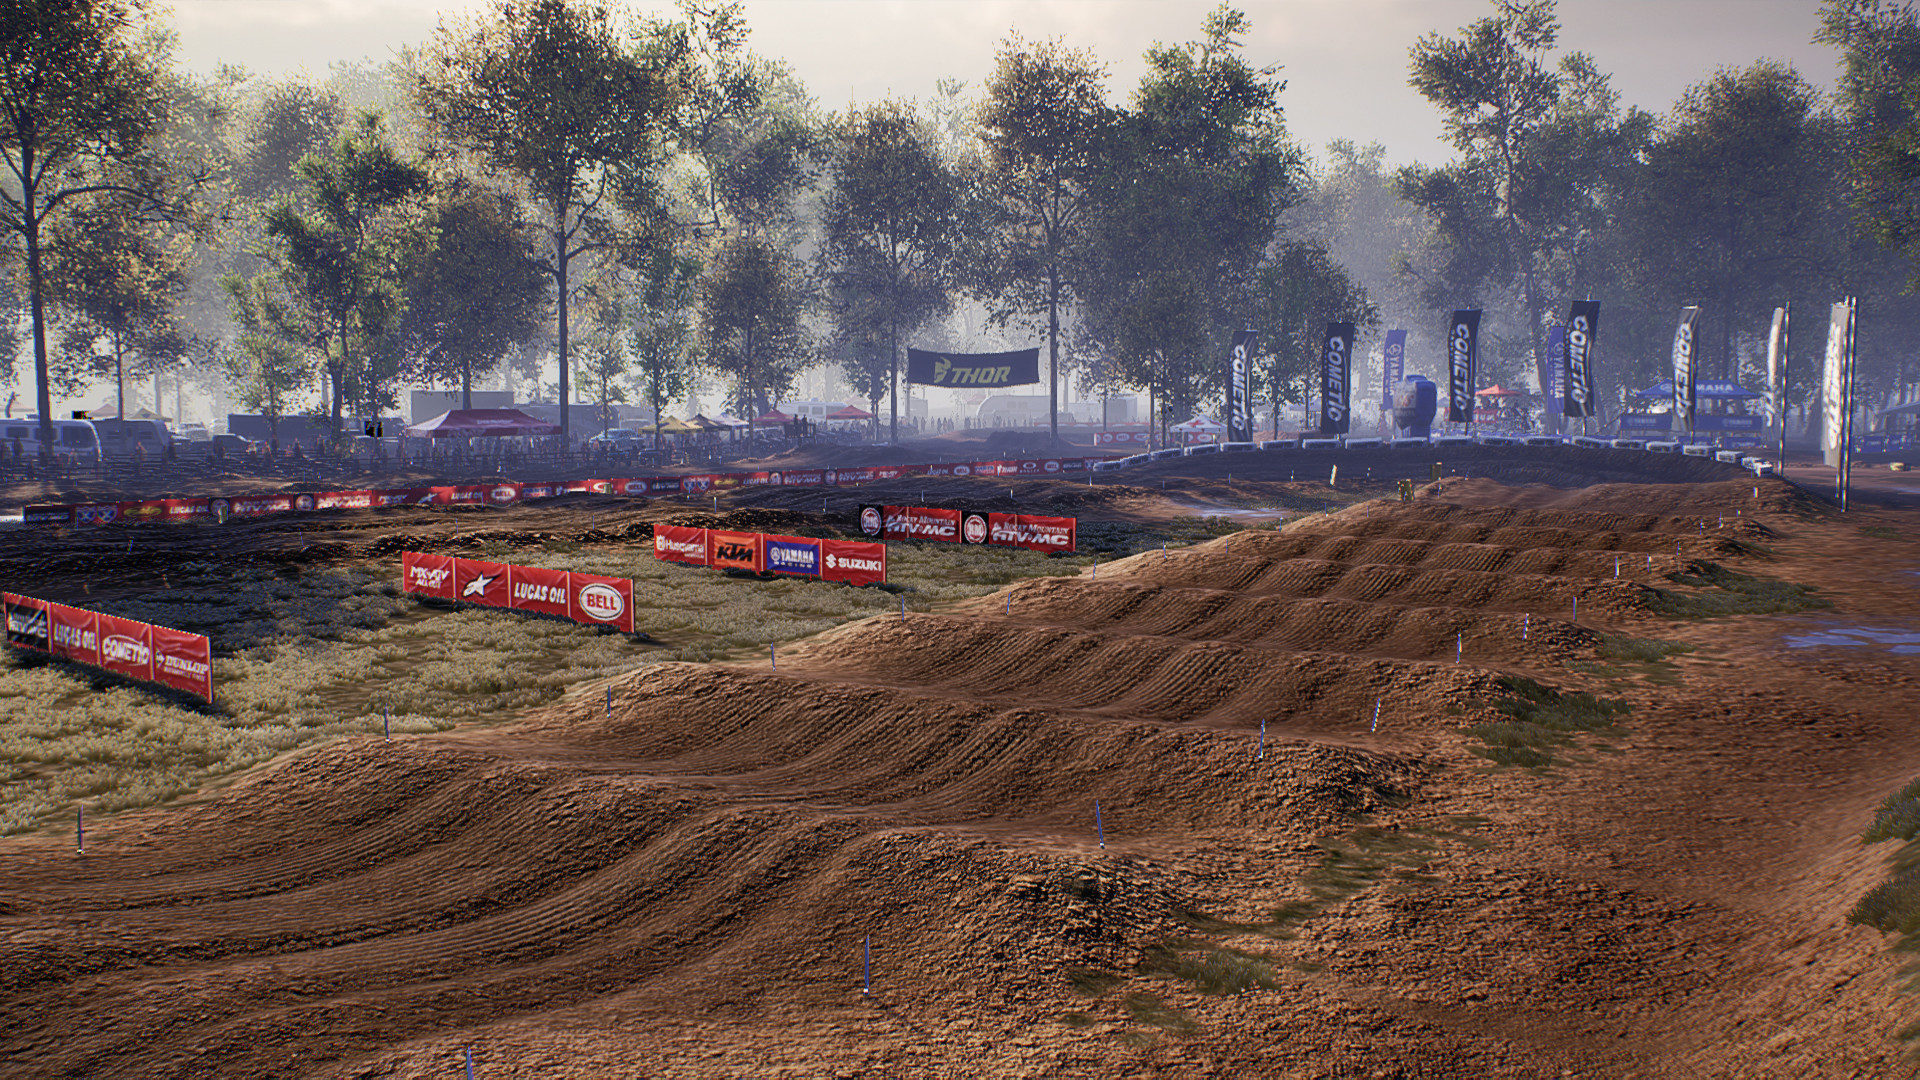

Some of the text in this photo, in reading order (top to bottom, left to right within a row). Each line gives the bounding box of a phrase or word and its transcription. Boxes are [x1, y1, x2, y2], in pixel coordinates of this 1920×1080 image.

[951, 366, 1011, 383] THOR
[1327, 336, 1347, 421] COMETIC
[1696, 384, 1734, 392] MAHA
[716, 542, 753, 562] KTM
[780, 548, 814, 564] YAMAHA
[837, 557, 882, 571] SUZUKI
[514, 581, 567, 604] LUCAS OIL
[586, 593, 618, 611] BELL
[53, 623, 97, 651] LUCAS OIL
[102, 636, 150, 665] COMETIC
[164, 654, 209, 675] DUNLOP
